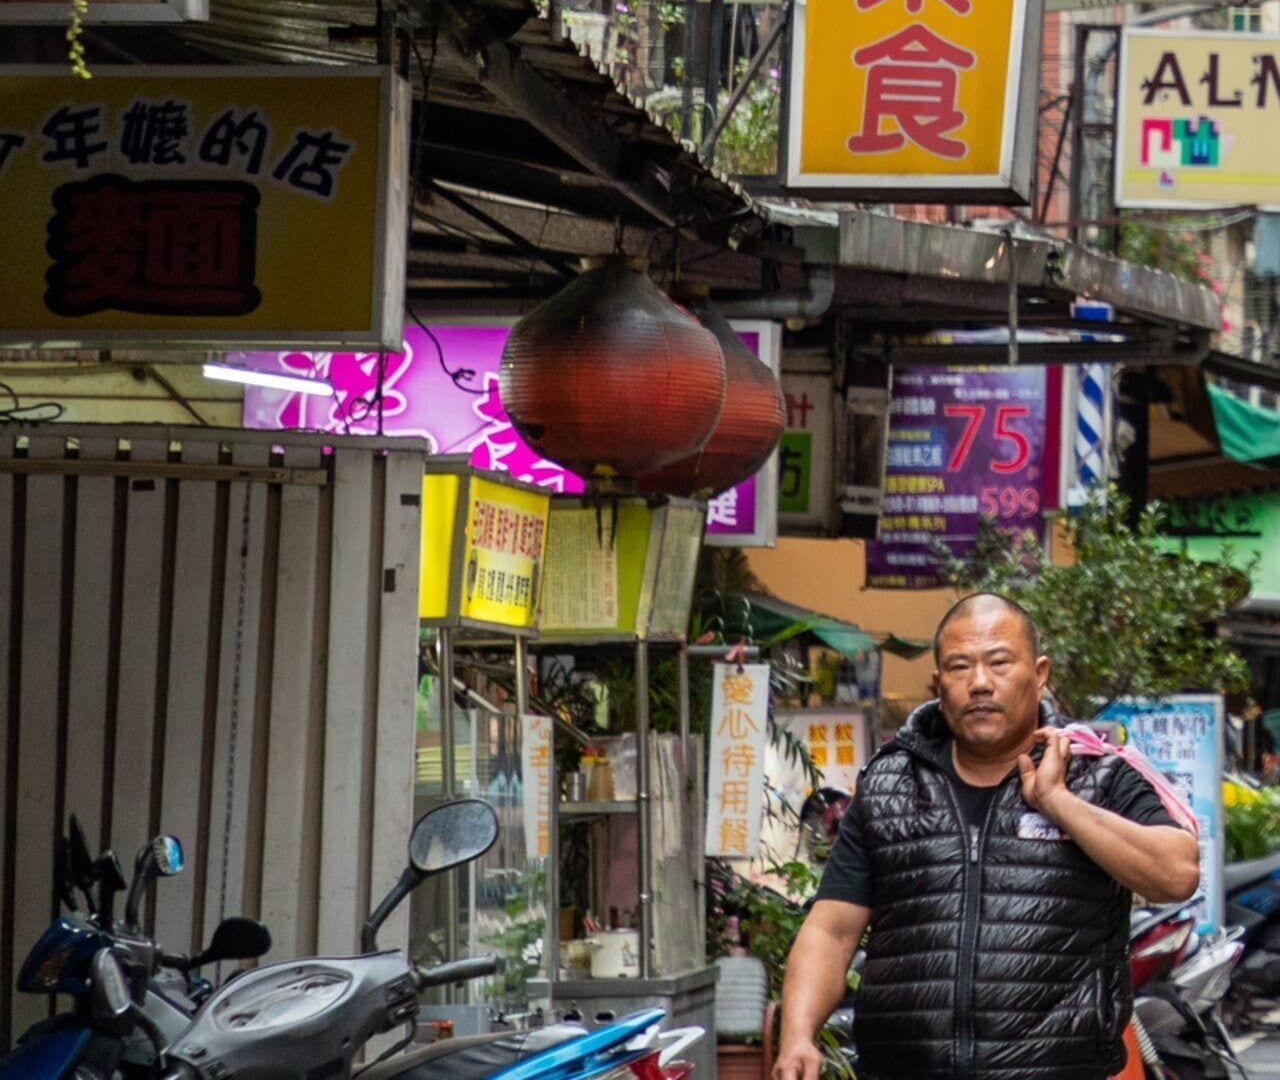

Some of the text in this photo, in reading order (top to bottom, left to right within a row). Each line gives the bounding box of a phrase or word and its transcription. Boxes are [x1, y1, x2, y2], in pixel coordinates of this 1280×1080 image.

[943, 403, 1030, 475] 75
[980, 485, 1040, 518] 599
[716, 673, 760, 855] 愛心待用餐
